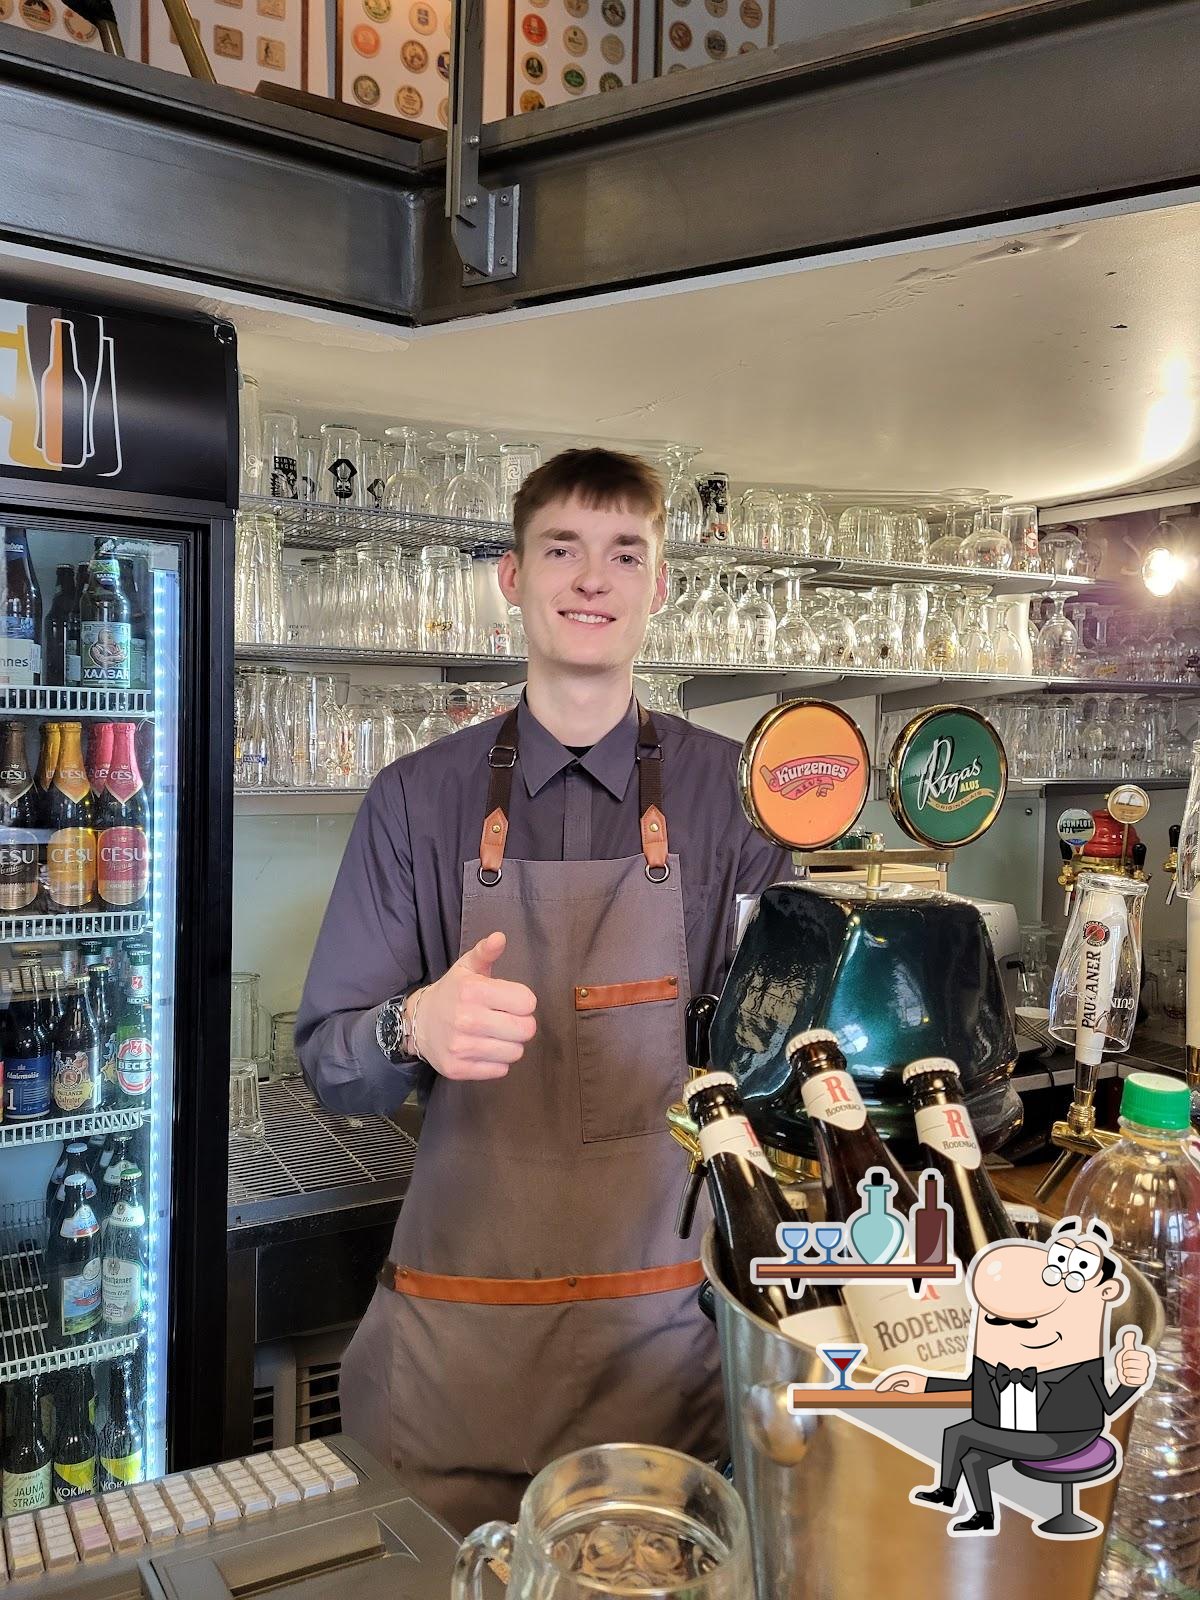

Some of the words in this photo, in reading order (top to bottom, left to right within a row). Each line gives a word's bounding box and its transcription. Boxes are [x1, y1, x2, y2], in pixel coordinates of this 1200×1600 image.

[775, 761, 850, 787] Kurzemes
[959, 779, 980, 793] ALUS
[1062, 819, 1092, 828] COMPLOT
[6, 1088, 17, 1111] 1
[821, 1075, 850, 1103] R
[942, 1109, 971, 1139] R
[916, 1334, 969, 1363] CLASSI
[14, 1480, 44, 1498] JAUNA
